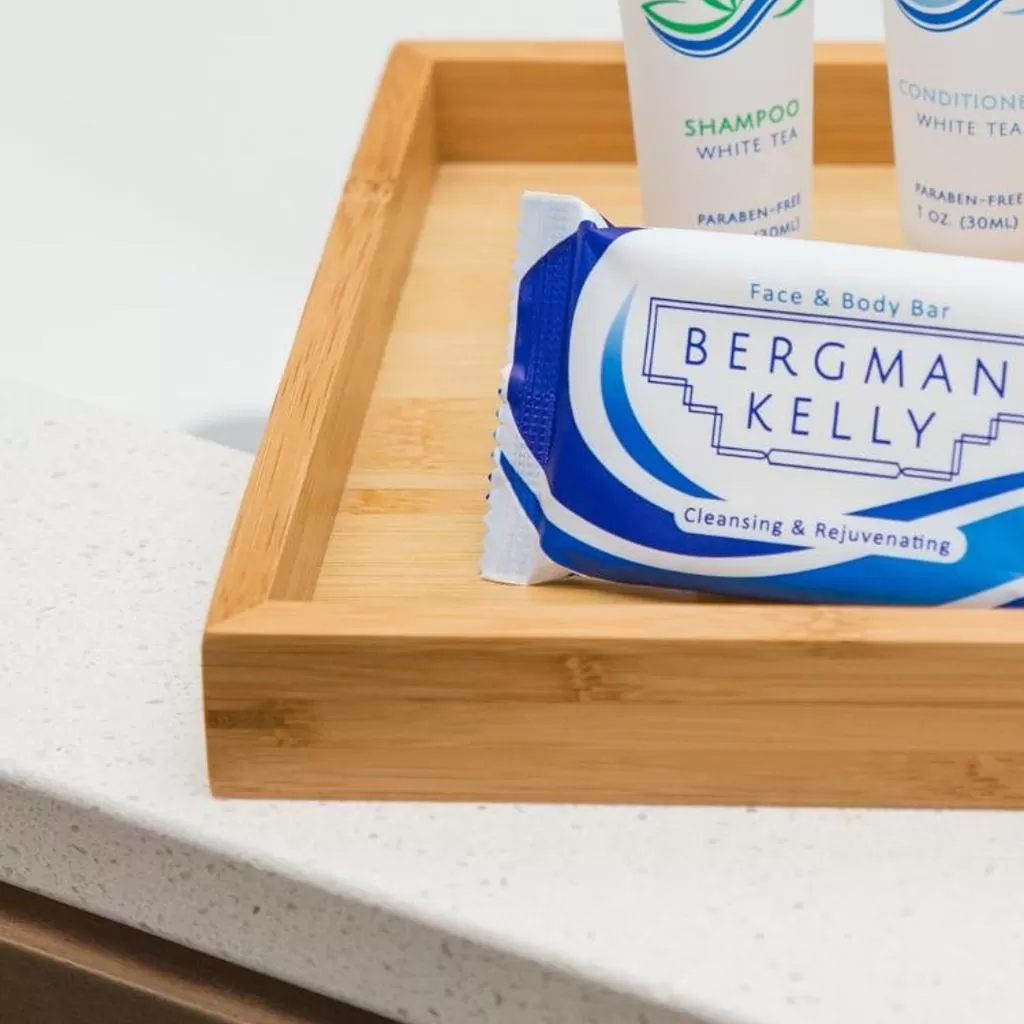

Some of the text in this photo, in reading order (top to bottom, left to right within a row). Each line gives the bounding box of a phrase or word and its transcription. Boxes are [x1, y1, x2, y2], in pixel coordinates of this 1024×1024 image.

[684, 98, 800, 138] SHAMPOO
[916, 112, 1023, 137] WHITE TEA
[696, 126, 799, 160] WHITE TEA
[914, 181, 1024, 206] PARABEN-FREE
[753, 216, 801, 237] 30ML)
[917, 203, 923, 219] 1
[959, 214, 1019, 231] (30ML)
[750, 283, 950, 319] Face & Body Bar
[684, 327, 1008, 399] BERGMAN
[747, 391, 937, 449] KELLY
[684, 507, 951, 557] Cleansing & Rejuvenating
